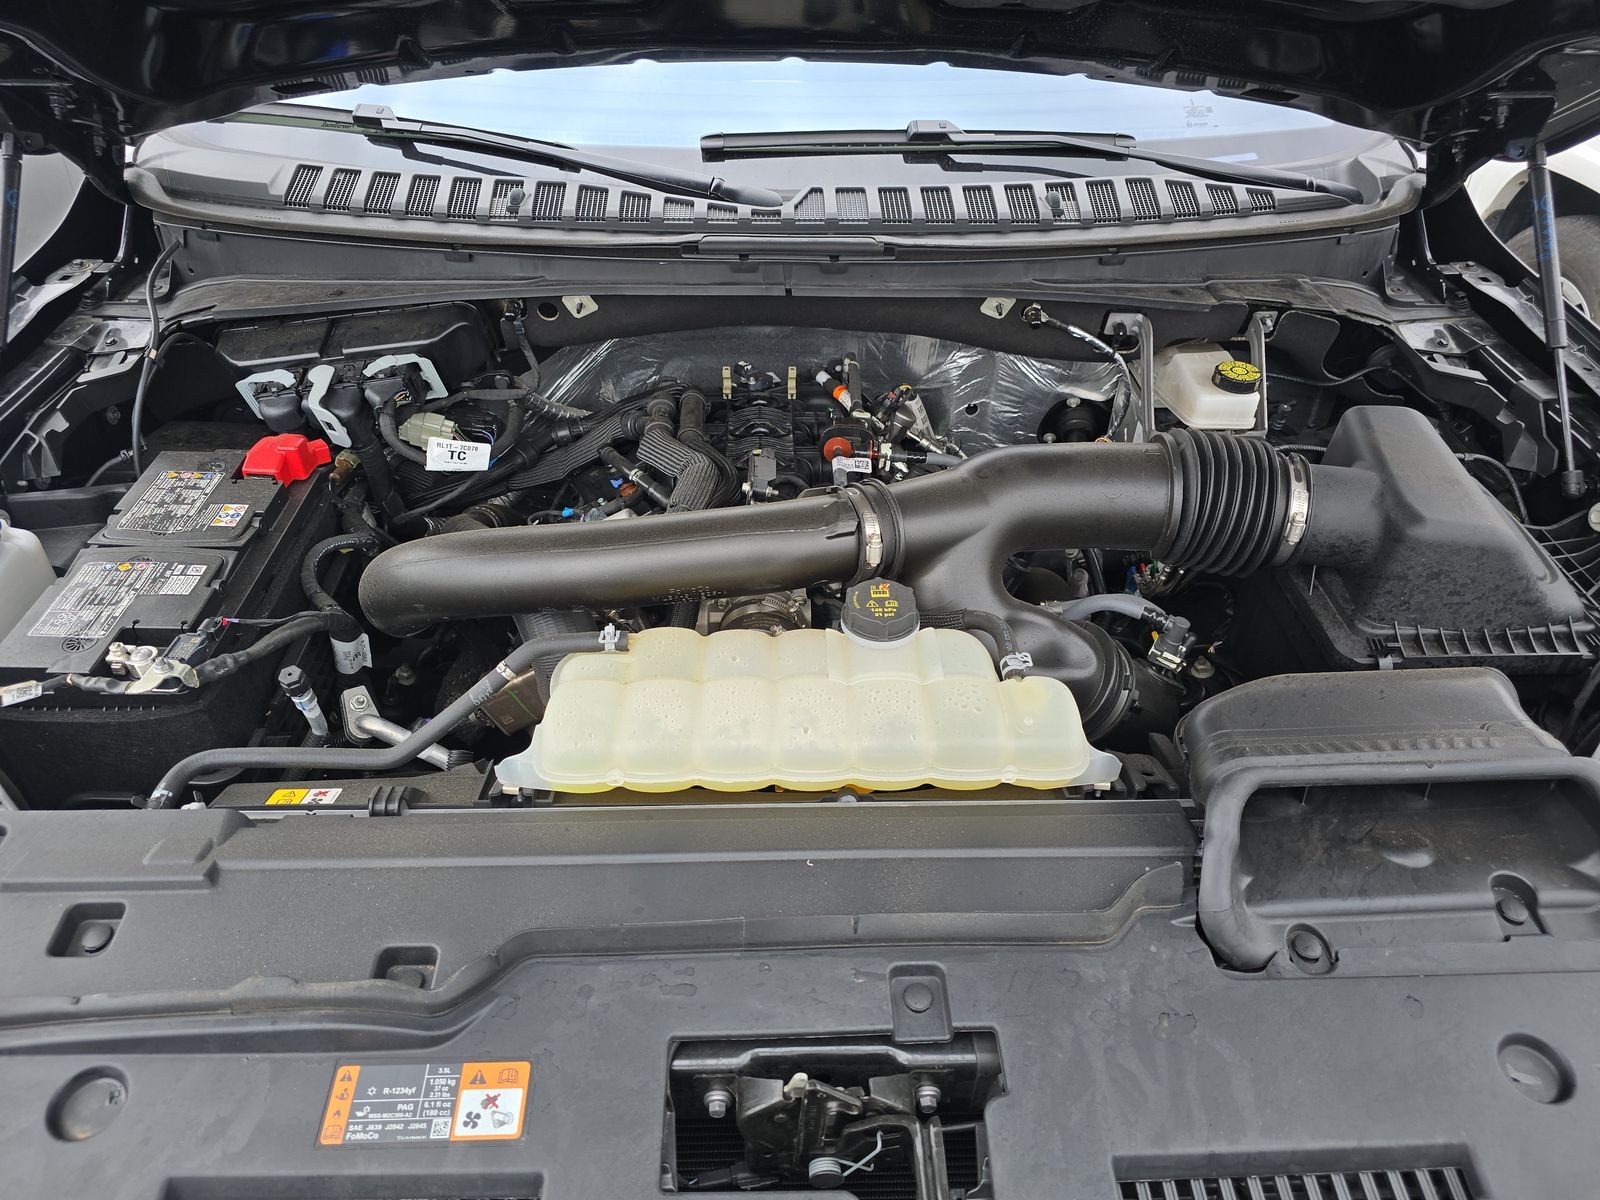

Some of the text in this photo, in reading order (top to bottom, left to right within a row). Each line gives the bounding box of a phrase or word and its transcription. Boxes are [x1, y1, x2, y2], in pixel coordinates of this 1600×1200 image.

[448, 450, 467, 461] TC
[447, 1078, 456, 1087] kg
[383, 1087, 417, 1096] R-1234yf
[397, 1103, 414, 1111] PAG
[422, 1109, 451, 1118] (180 cc)
[345, 1132, 379, 1140] FoMoCo
